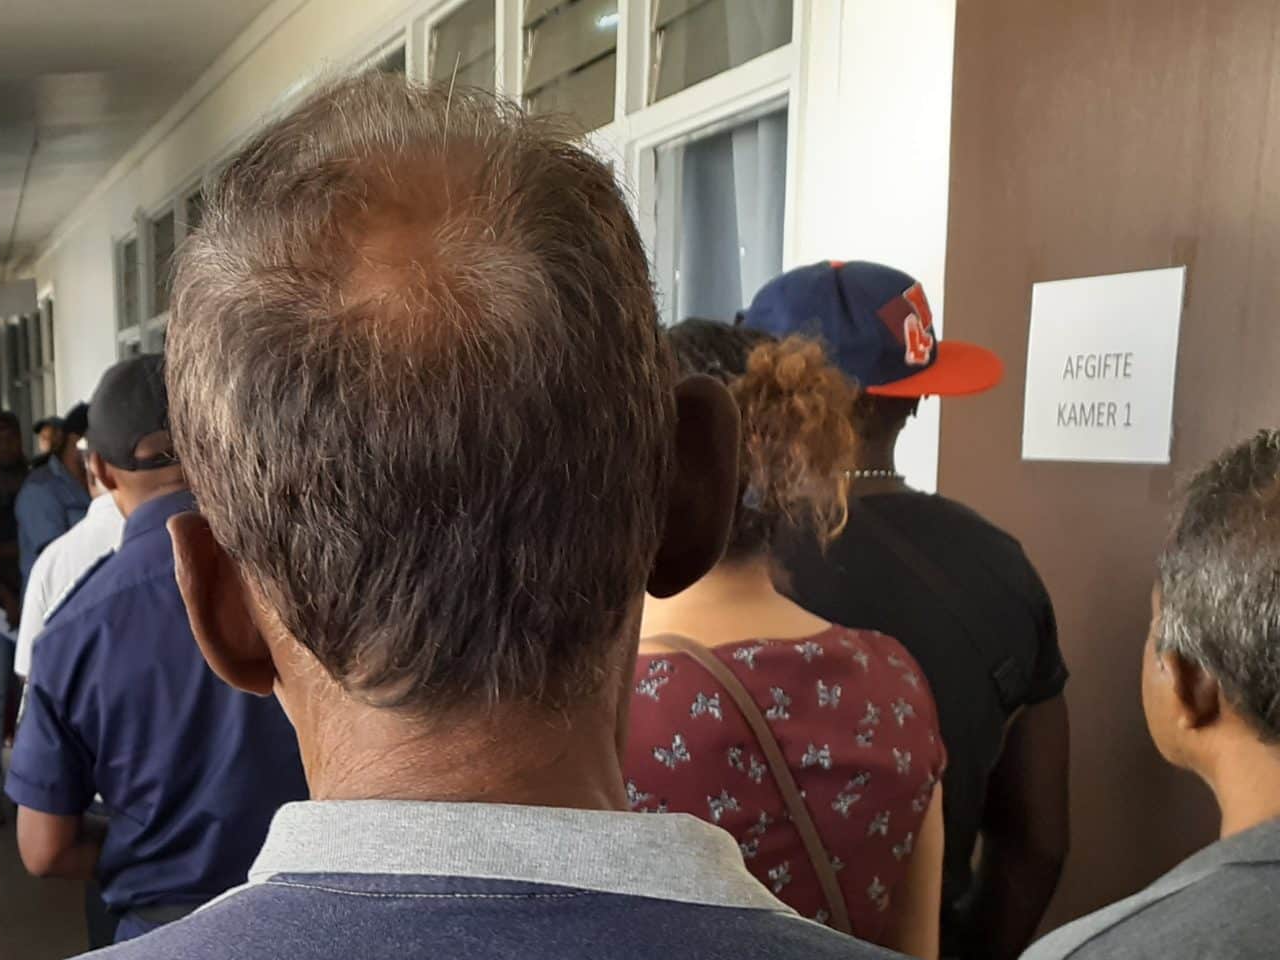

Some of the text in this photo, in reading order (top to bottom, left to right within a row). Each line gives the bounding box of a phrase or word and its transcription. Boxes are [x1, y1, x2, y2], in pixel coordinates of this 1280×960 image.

[1062, 351, 1134, 380] AFGIFTE
[1056, 401, 1132, 428] KAMER 1
